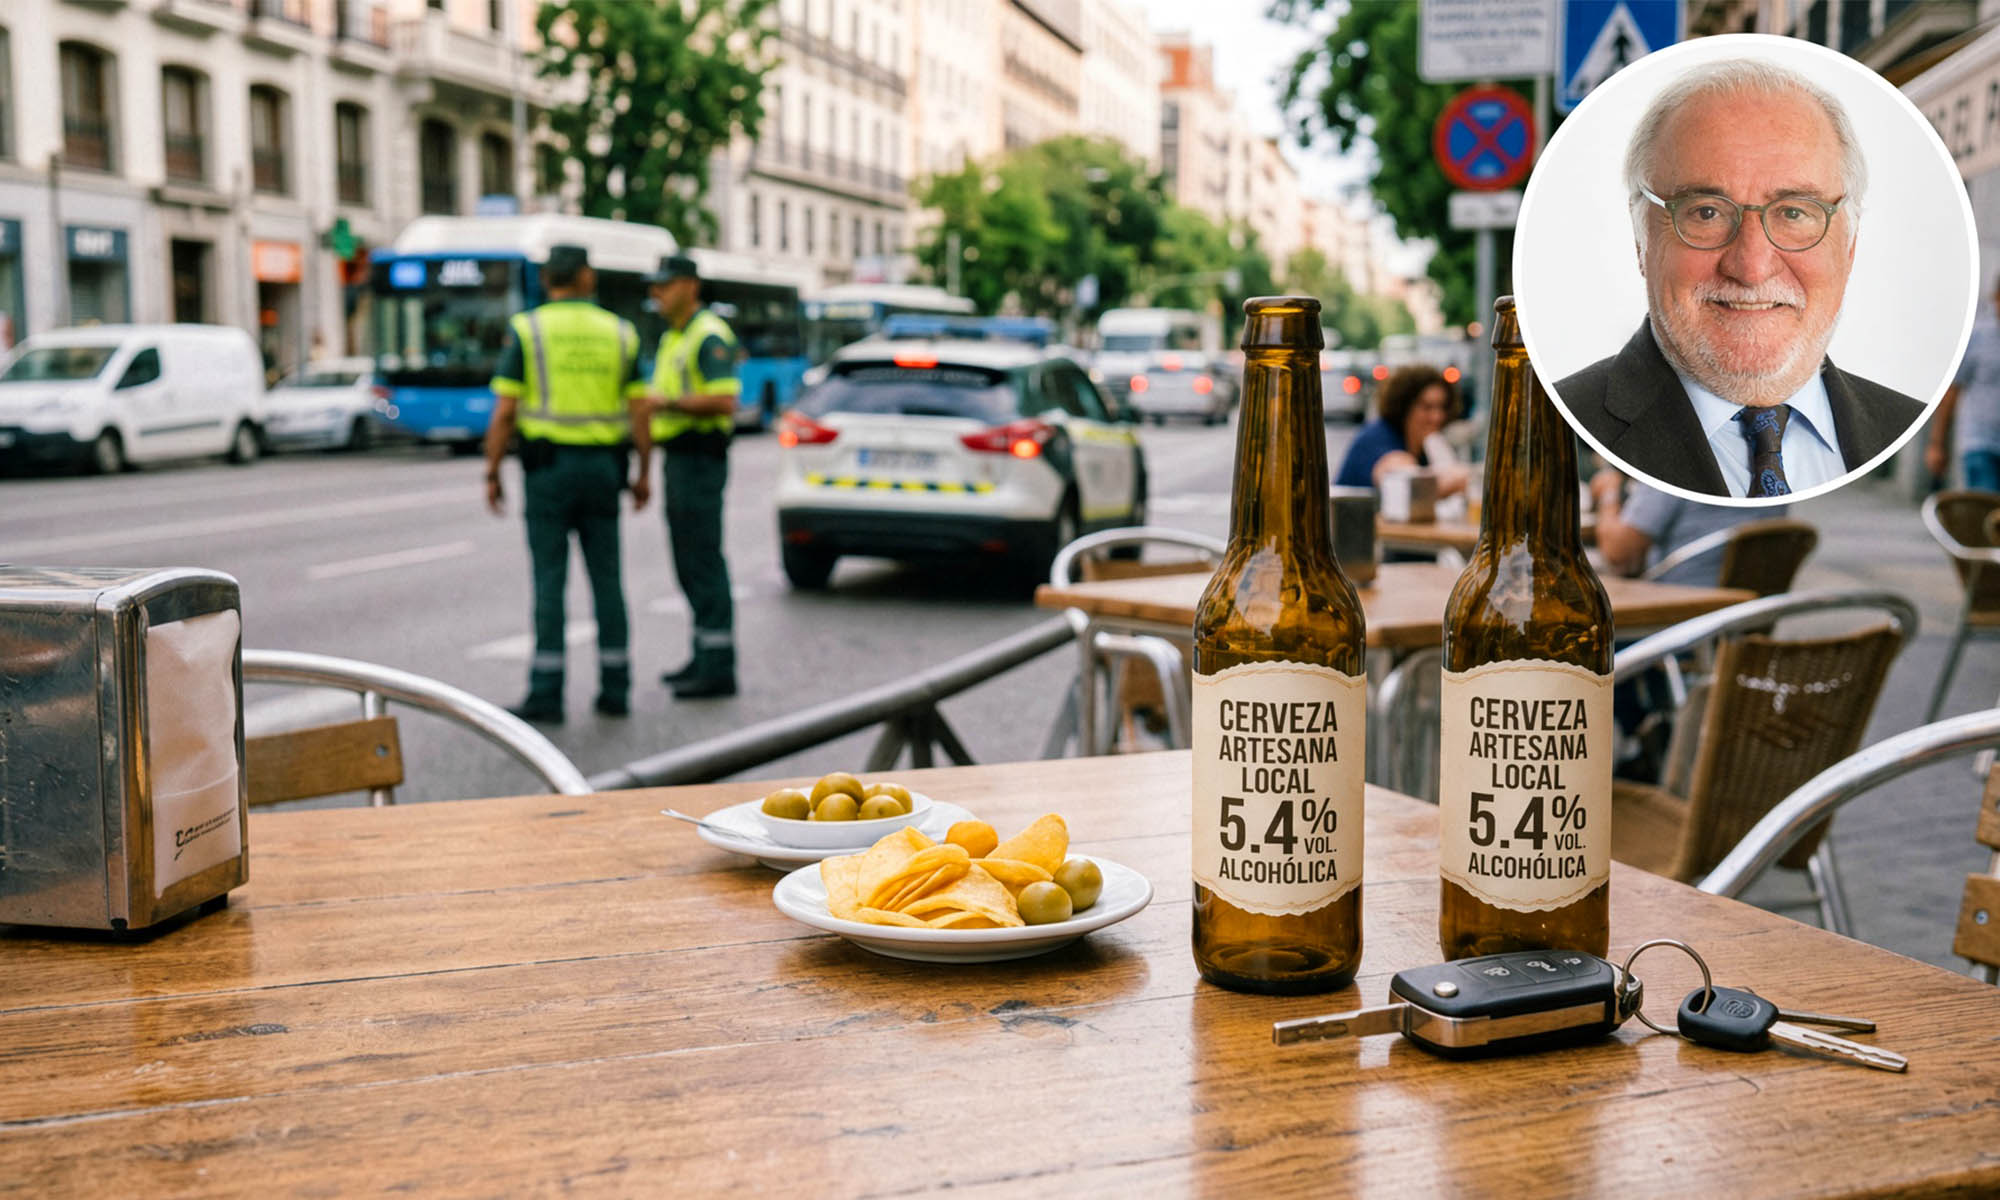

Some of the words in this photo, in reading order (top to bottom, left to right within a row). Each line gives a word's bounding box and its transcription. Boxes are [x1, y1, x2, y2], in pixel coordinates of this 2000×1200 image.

[1219, 699, 1338, 734] CERVEZA
[1470, 696, 1588, 731] CERVEZA
[1219, 735, 1338, 764] ARTESANA
[1469, 731, 1588, 761] ARTESANA
[1241, 767, 1315, 794] LOCAL
[1491, 763, 1566, 790] LOCAL
[1303, 836, 1338, 855] VOL.
[1553, 833, 1587, 851] VOL.
[1218, 856, 1338, 885] ALCOHÓLICA
[1468, 852, 1587, 880] ALCOHÓLICA
